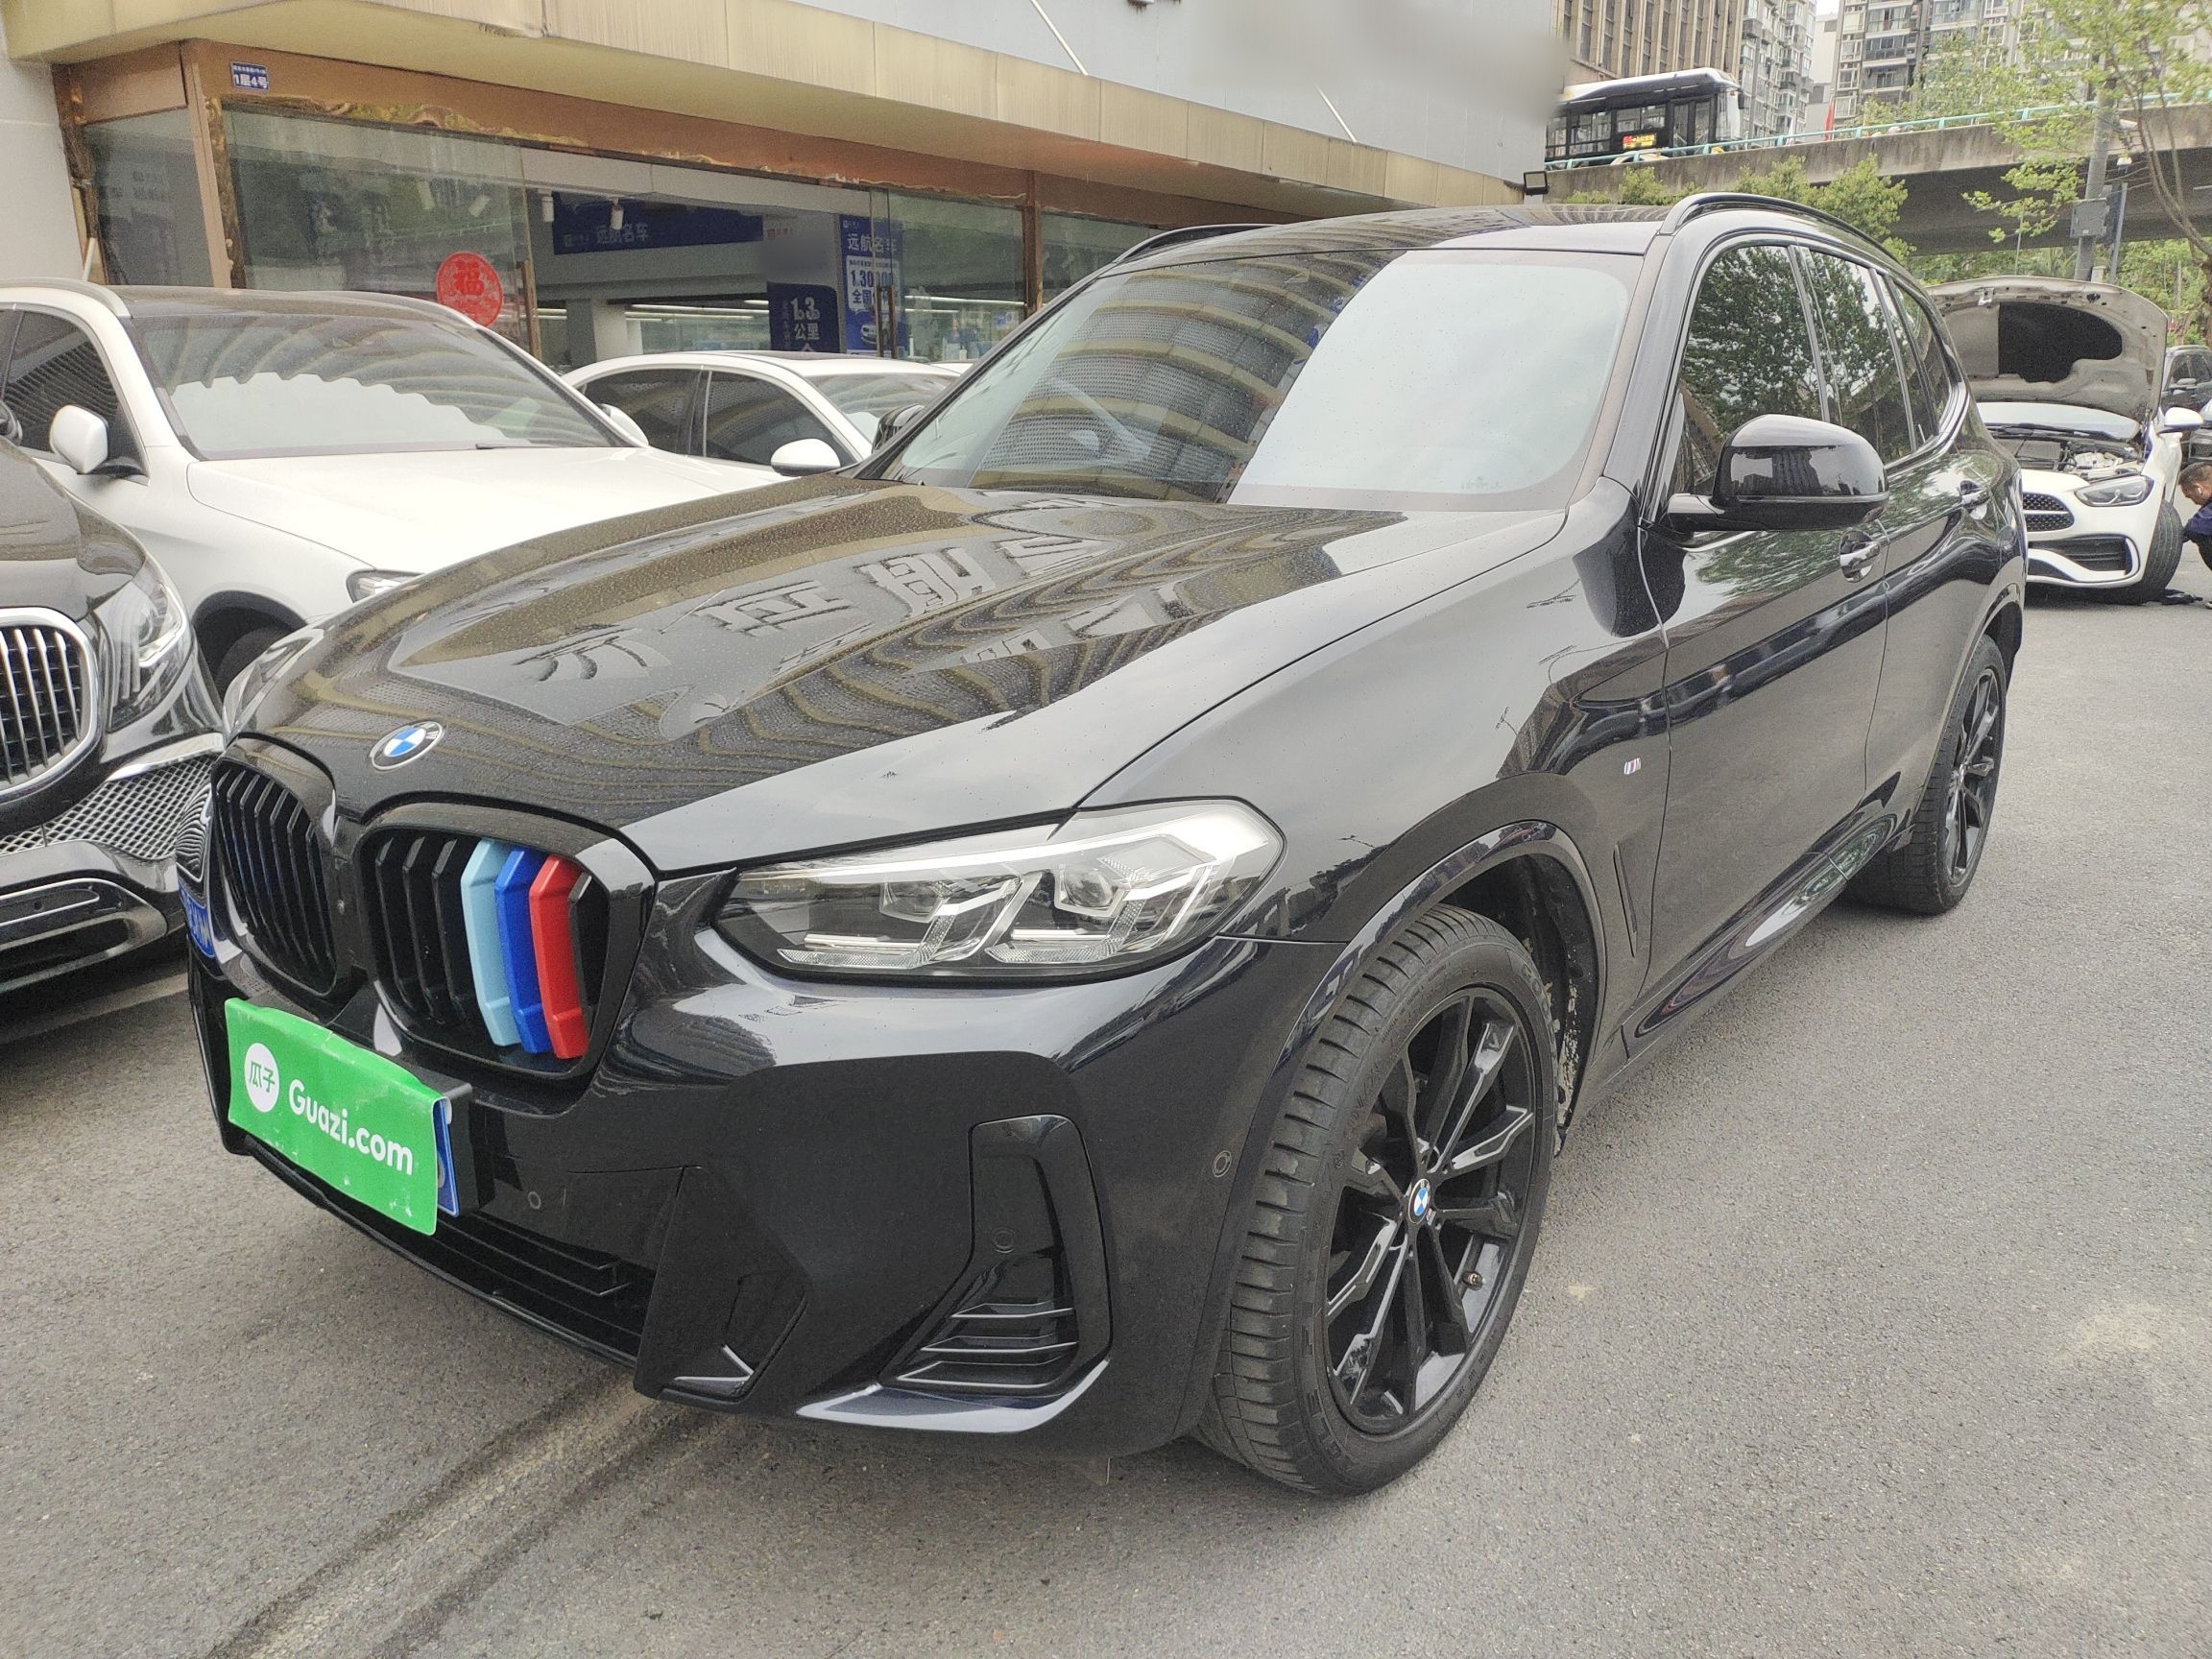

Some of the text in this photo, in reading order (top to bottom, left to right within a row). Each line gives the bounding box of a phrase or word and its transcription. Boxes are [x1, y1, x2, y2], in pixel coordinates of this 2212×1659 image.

[234, 73, 269, 89] 1层4号
[794, 322, 821, 340] 公里
[249, 1061, 276, 1093] 瓜子
[289, 1078, 413, 1176] Guazi.com
